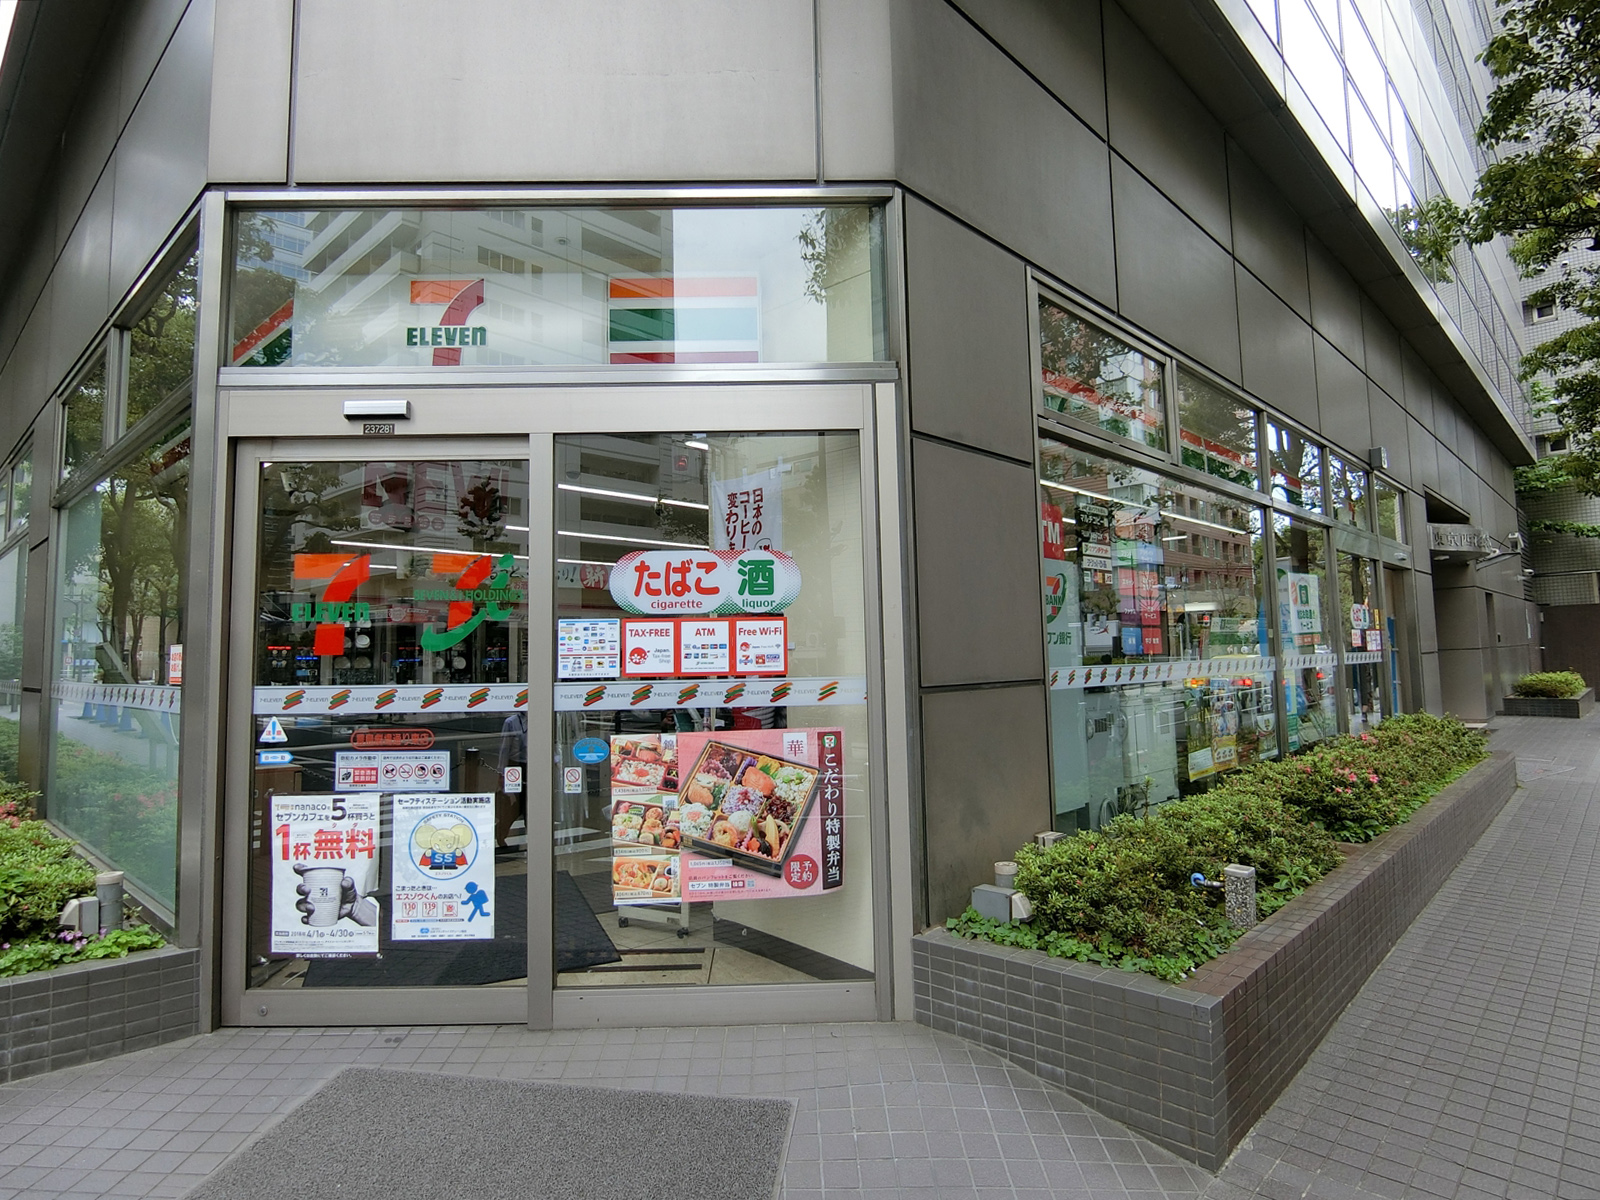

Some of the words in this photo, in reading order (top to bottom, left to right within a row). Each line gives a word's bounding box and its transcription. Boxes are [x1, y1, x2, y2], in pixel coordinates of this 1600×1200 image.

[364, 424, 393, 434] 237281
[751, 487, 764, 536] 日本の
[1041, 520, 1061, 545] TM
[633, 558, 720, 597] たばこ
[737, 559, 775, 596] 酒
[466, 589, 524, 601] HOLDINGS
[650, 600, 703, 611] cigarette
[742, 599, 776, 610] liquor
[628, 628, 671, 638] TAX-FREE
[695, 628, 716, 637] ATM
[738, 627, 757, 636] Free
[759, 627, 782, 636] Wi-Fi
[787, 739, 804, 757] 華
[423, 813, 442, 824] SAFETY
[443, 813, 465, 823] STATION
[823, 752, 841, 882] こだわり特製弁当
[275, 824, 376, 860] 1杯無料
[434, 853, 453, 863] SS
[790, 861, 802, 883] 限定
[802, 861, 813, 882] 予約
